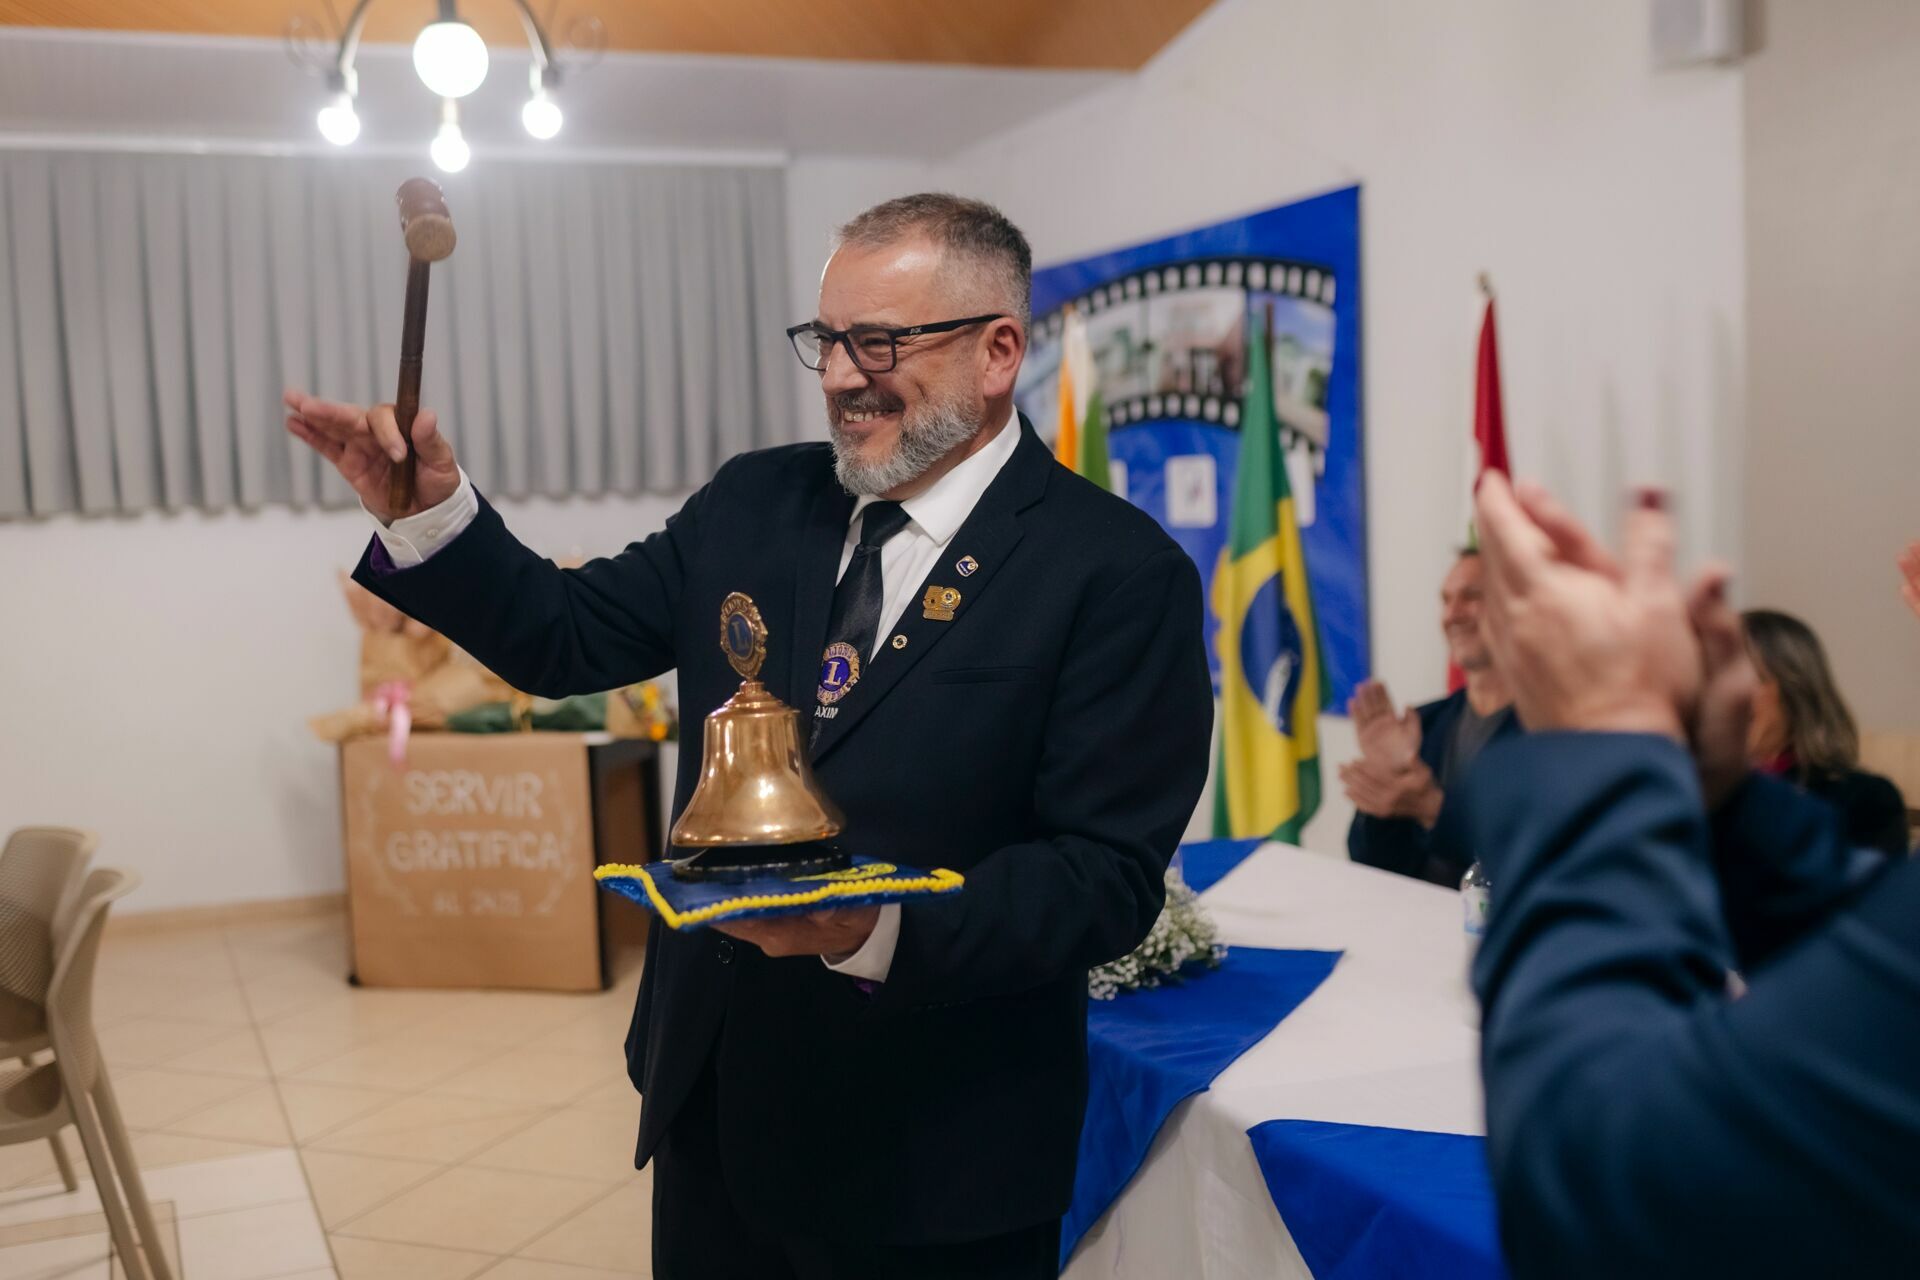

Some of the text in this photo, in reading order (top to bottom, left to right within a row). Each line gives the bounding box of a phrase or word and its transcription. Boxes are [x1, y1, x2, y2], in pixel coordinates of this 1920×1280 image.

[824, 660, 842, 686] L
[404, 769, 544, 819] SERVIR
[386, 828, 563, 873] GRATIFICA
